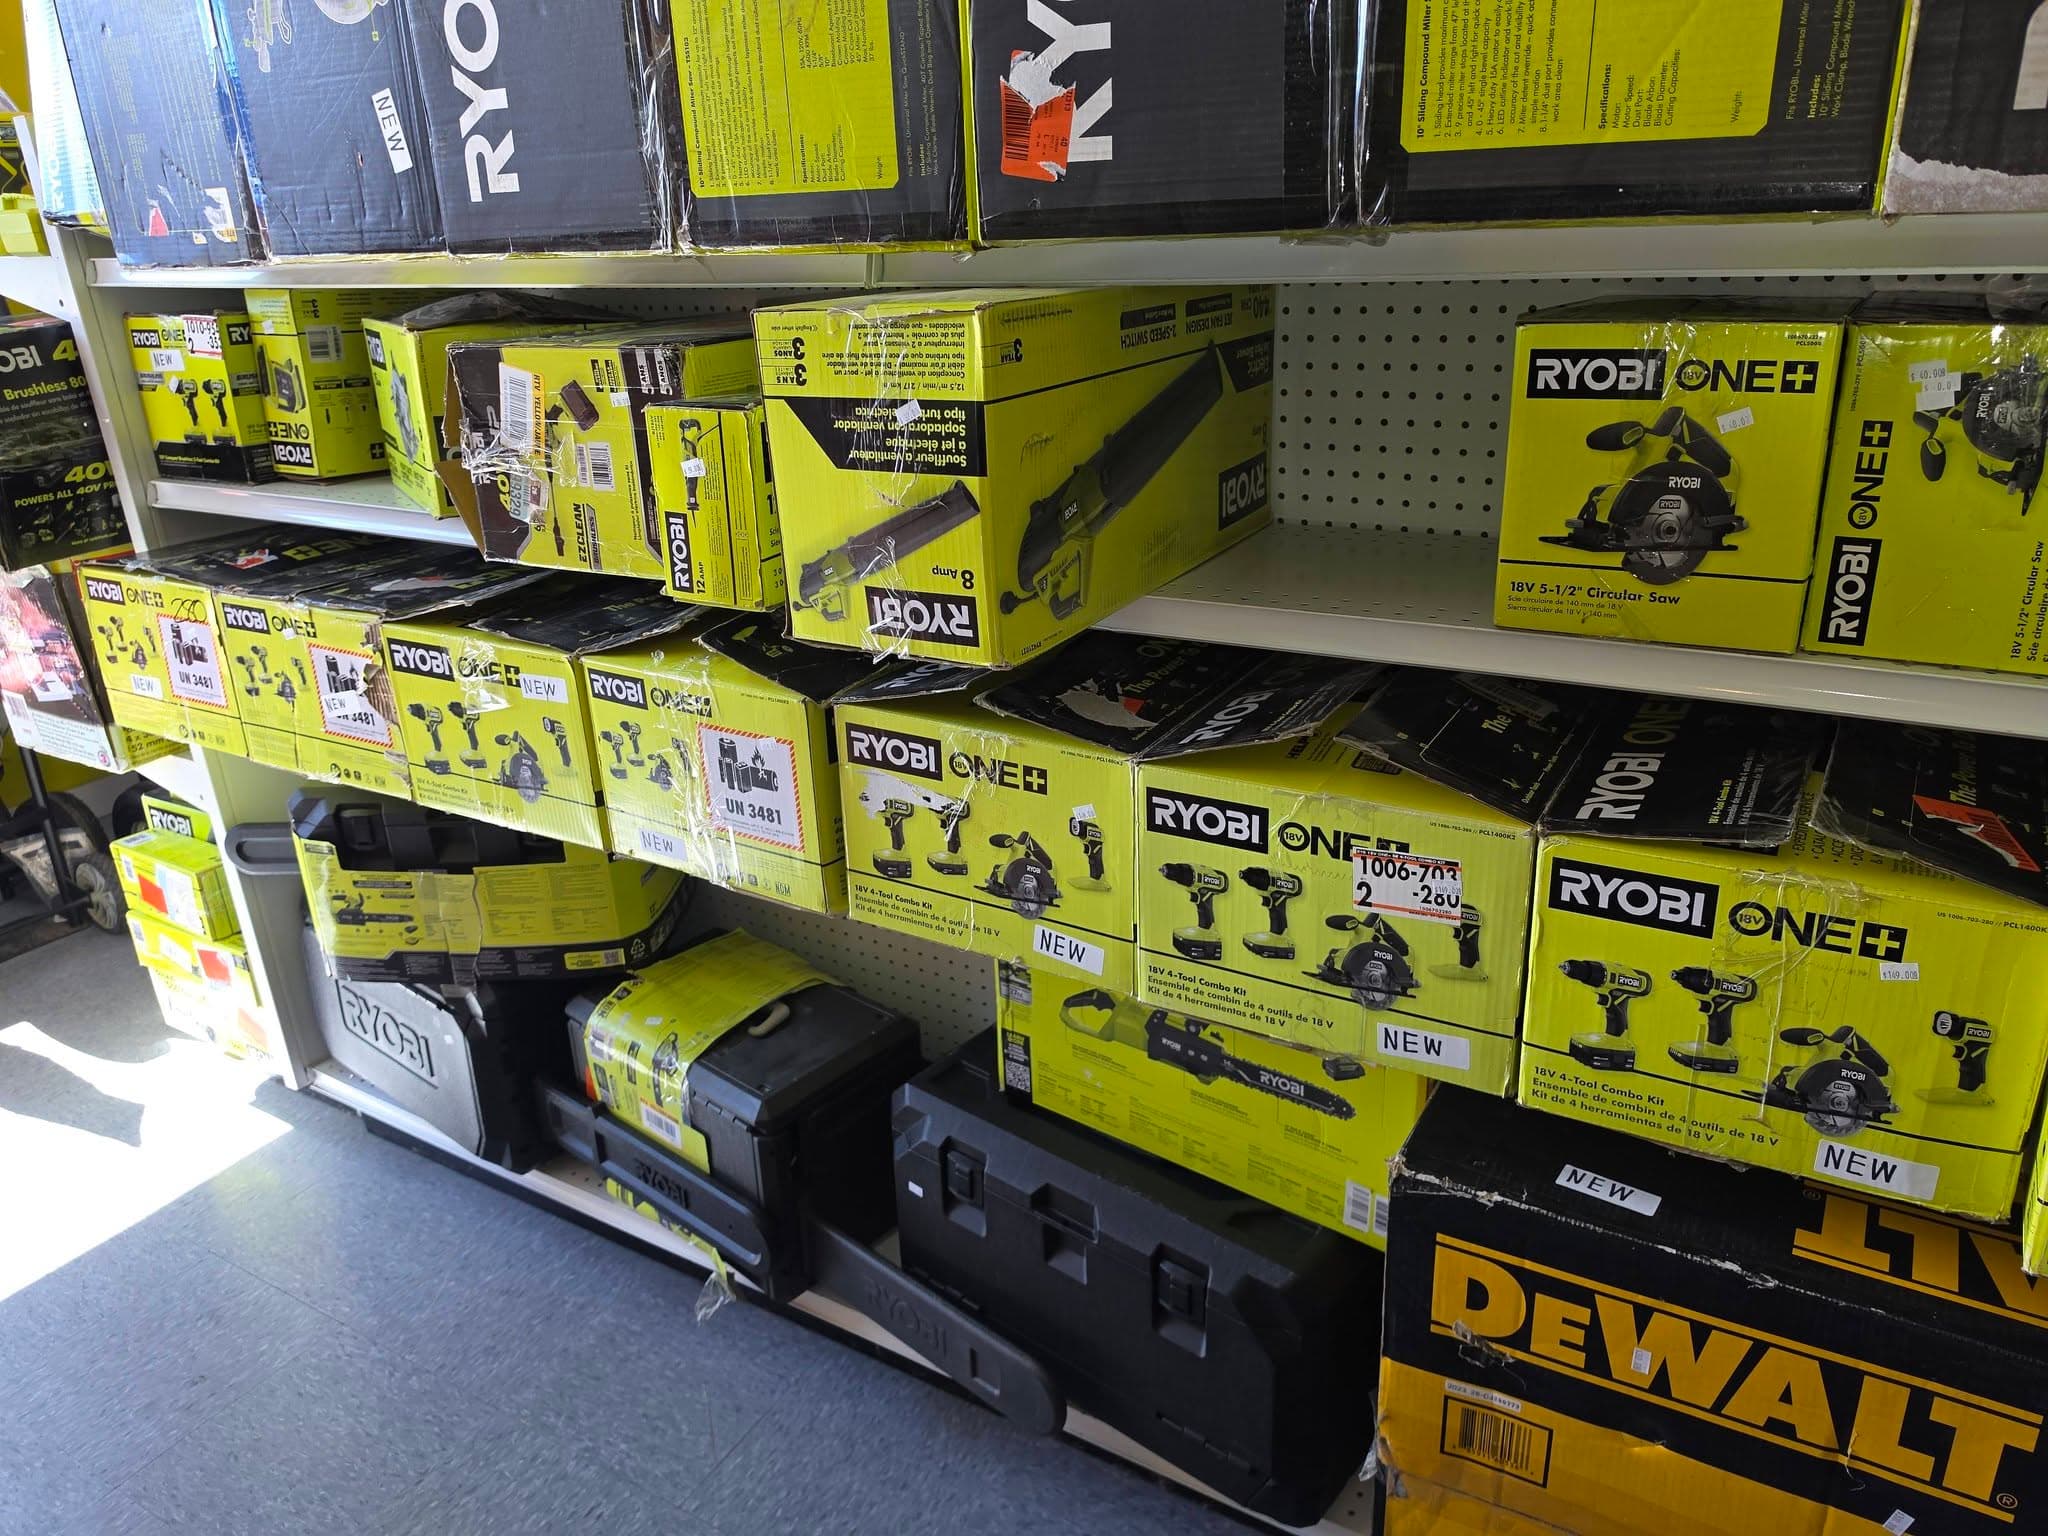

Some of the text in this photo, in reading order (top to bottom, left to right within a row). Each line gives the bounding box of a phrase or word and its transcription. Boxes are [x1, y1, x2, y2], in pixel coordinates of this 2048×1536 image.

[1493, 5, 1503, 26] easily
[1448, 26, 1457, 44] from
[1479, 18, 1491, 72] bevel capacity
[1522, 14, 1535, 76] override quick
[1545, 29, 1555, 61] provides
[1794, 27, 1806, 66] Universal
[1418, 5, 1431, 122] Sliding Compound Miter
[1438, 48, 1446, 80] provides
[1449, 47, 1457, 69] range
[1457, 19, 1469, 119] precise located
[1501, 47, 1510, 80] indicator
[1509, 2, 1525, 124] accuracy visibility
[1554, 59, 1563, 81] clean
[1821, 21, 1840, 101] Sliding Compound
[1532, 69, 1540, 96] motion
[1657, 61, 1668, 99] Diameter:
[1668, 49, 1680, 100] Capacities:
[1489, 82, 1497, 99] duty
[1599, 64, 1612, 129] Specifications:
[1808, 74, 1821, 118] Includes:
[1435, 104, 1443, 129] Sliding
[1445, 93, 1454, 127] Extended
[1488, 101, 1496, 125] Heavy
[375, 96, 404, 152] NEW
[688, 88, 704, 175] Sliding Compound Miter
[799, 134, 808, 183] Specifications:
[132, 332, 159, 346] RYOBI
[792, 337, 805, 360] 3
[1120, 324, 1176, 349] 2-SPEED SWITCH
[153, 353, 172, 366] NEW
[776, 363, 807, 386] 3 ANS
[928, 370, 965, 378] Conception
[1535, 358, 1657, 392] RYOBI
[1675, 359, 1820, 394] ONE+
[3, 382, 68, 401] Brushless
[943, 407, 966, 420] tipo
[1976, 393, 1991, 419] RYOBI
[833, 420, 885, 431] ventilador
[274, 445, 312, 464] RYOBI
[885, 437, 966, 452] à jet électrique
[905, 453, 967, 467] Souffleur à
[1668, 476, 1701, 489] RYOBI
[1847, 420, 1893, 530] ONE+
[15, 483, 101, 508] POWERS ALL 40V
[1222, 463, 1265, 518] RYOBI
[573, 503, 587, 563] EZCLEAN
[588, 516, 599, 563] BRUSHLESS
[669, 517, 690, 589] RYOBI
[697, 580, 705, 594] 12
[960, 568, 975, 590] 8
[1827, 544, 1872, 639] RYOBI
[86, 580, 164, 608] RYOBI ONE+
[1510, 581, 1681, 606] 18V 5-1/2" Circular Saw
[2011, 541, 2044, 658] 18V 5-1/2" Circular Saw
[224, 607, 268, 631] RYOBI
[871, 595, 973, 638] RYOBI
[390, 644, 452, 675] RYOBI
[133, 676, 154, 692] NEW
[179, 671, 214, 689] UN 3481
[523, 677, 555, 696] NEW
[590, 674, 644, 704] RYOBI
[326, 697, 346, 712] NEW
[850, 731, 1048, 795] RYOBI ONE+
[1576, 752, 1666, 820] RYOBI
[150, 809, 192, 836] RYOBI
[726, 798, 782, 825] UN 3481
[1152, 796, 1259, 845] RYOBI
[641, 833, 673, 853] NEW
[1479, 829, 1516, 841] PCL1400K2
[855, 884, 920, 907] 18V 4-Tool Combo
[855, 894, 889, 910] Ensemble
[1356, 881, 1372, 908] 2
[1560, 868, 1706, 927] RYOBI
[884, 910, 934, 928] herramientas
[1728, 900, 1908, 962] ONE+
[1040, 929, 1086, 963] NEW
[1374, 950, 1393, 961] RYOBI
[1148, 965, 1247, 997] 18V 4-Tool Combo Kit
[1618, 975, 1640, 988] RYOBI
[1722, 982, 1744, 994] RYOBI
[1148, 975, 1294, 1020] Ensemble combin outils
[1184, 994, 1247, 1017] herramientas
[341, 985, 436, 1078] RYOBI
[1383, 1027, 1442, 1057] NEW
[1968, 1028, 1990, 1037] RYOBI
[1258, 1070, 1305, 1097] RYOBI
[1534, 1066, 1665, 1106] 18V 4-Tool Combo Kit
[1841, 1068, 1866, 1081] RYOBI
[1532, 1078, 1726, 1136] Ensemble combin outils
[1580, 1101, 1663, 1128] herramientas
[1824, 1144, 1898, 1184] NEW
[635, 1158, 690, 1210] RYOBI
[1566, 1169, 1634, 1202] NEW
